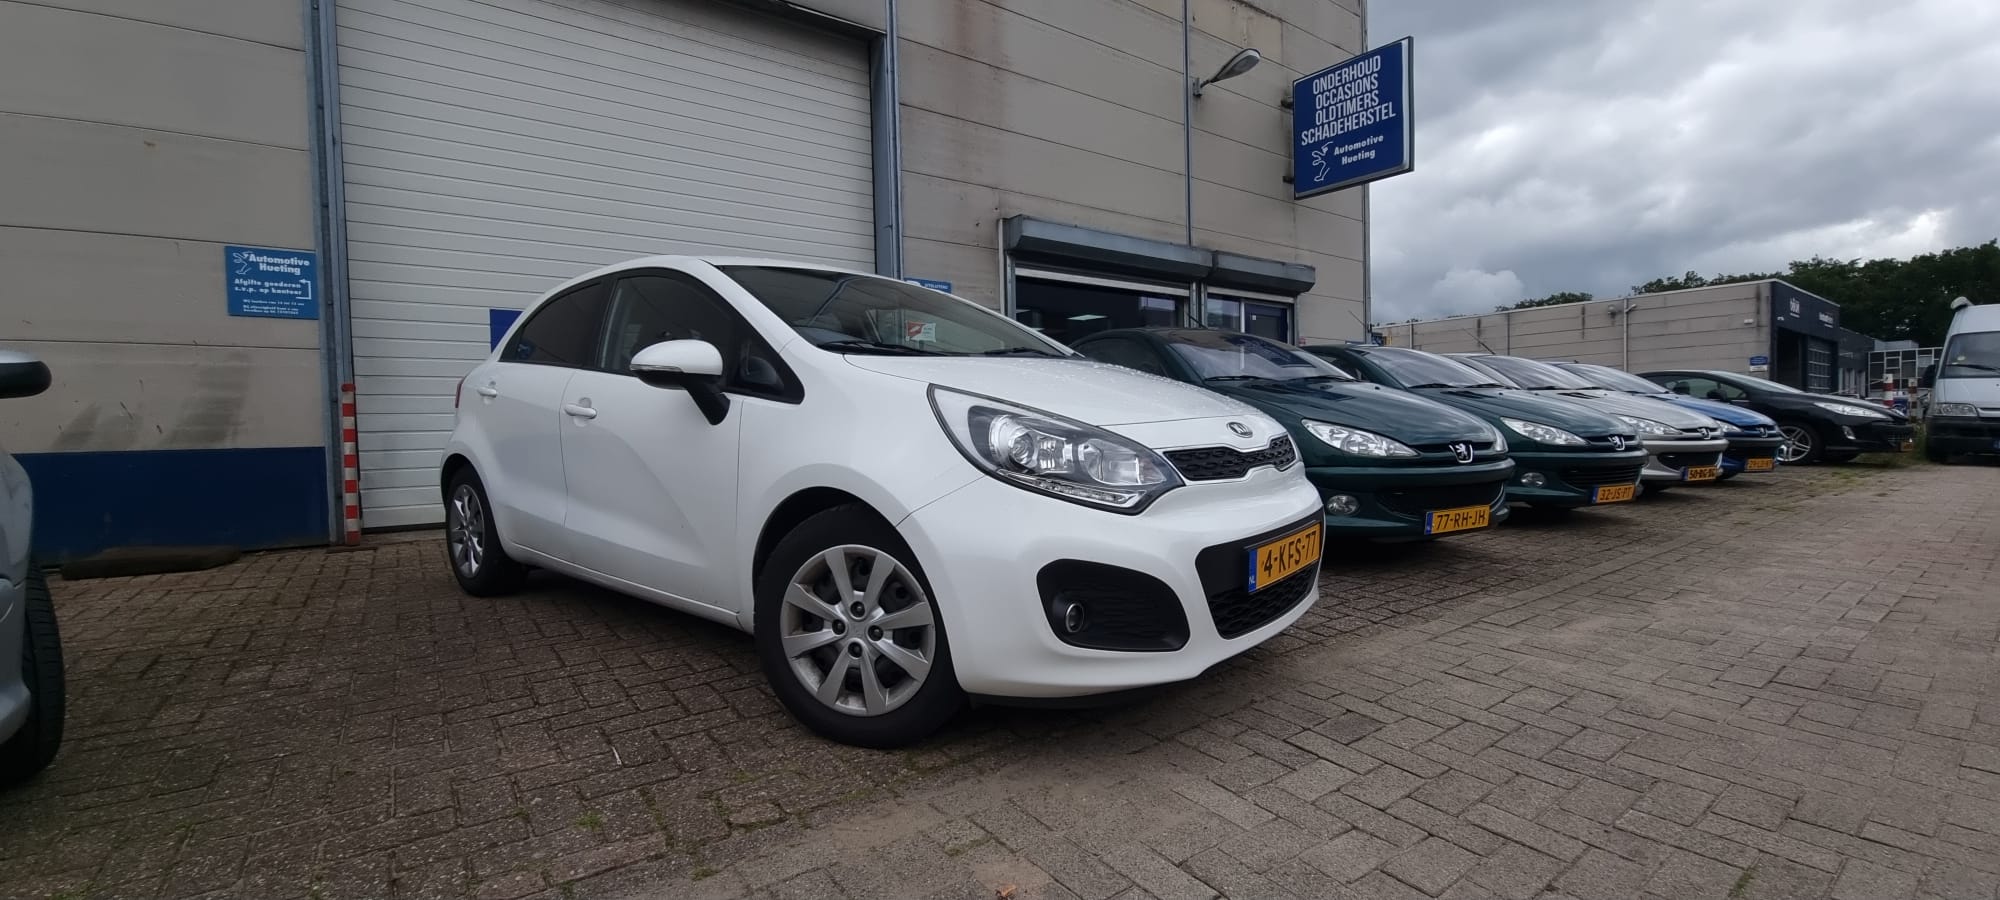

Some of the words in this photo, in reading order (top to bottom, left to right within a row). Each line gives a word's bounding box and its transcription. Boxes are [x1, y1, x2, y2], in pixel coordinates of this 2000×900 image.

[1312, 55, 1382, 95] ONDERHOUD
[1315, 73, 1379, 110] OCCASIONS
[1315, 90, 1379, 125] OLDTIMERS
[1301, 101, 1397, 146] SCHADEHERSTEL
[1334, 135, 1384, 155] Automotive
[1341, 149, 1376, 165] Hueting
[248, 253, 310, 266] Automotive
[259, 263, 301, 275] Hueting
[1437, 510, 1486, 531] 77-RH-JH
[1263, 530, 1317, 578] 4-KFS-77
